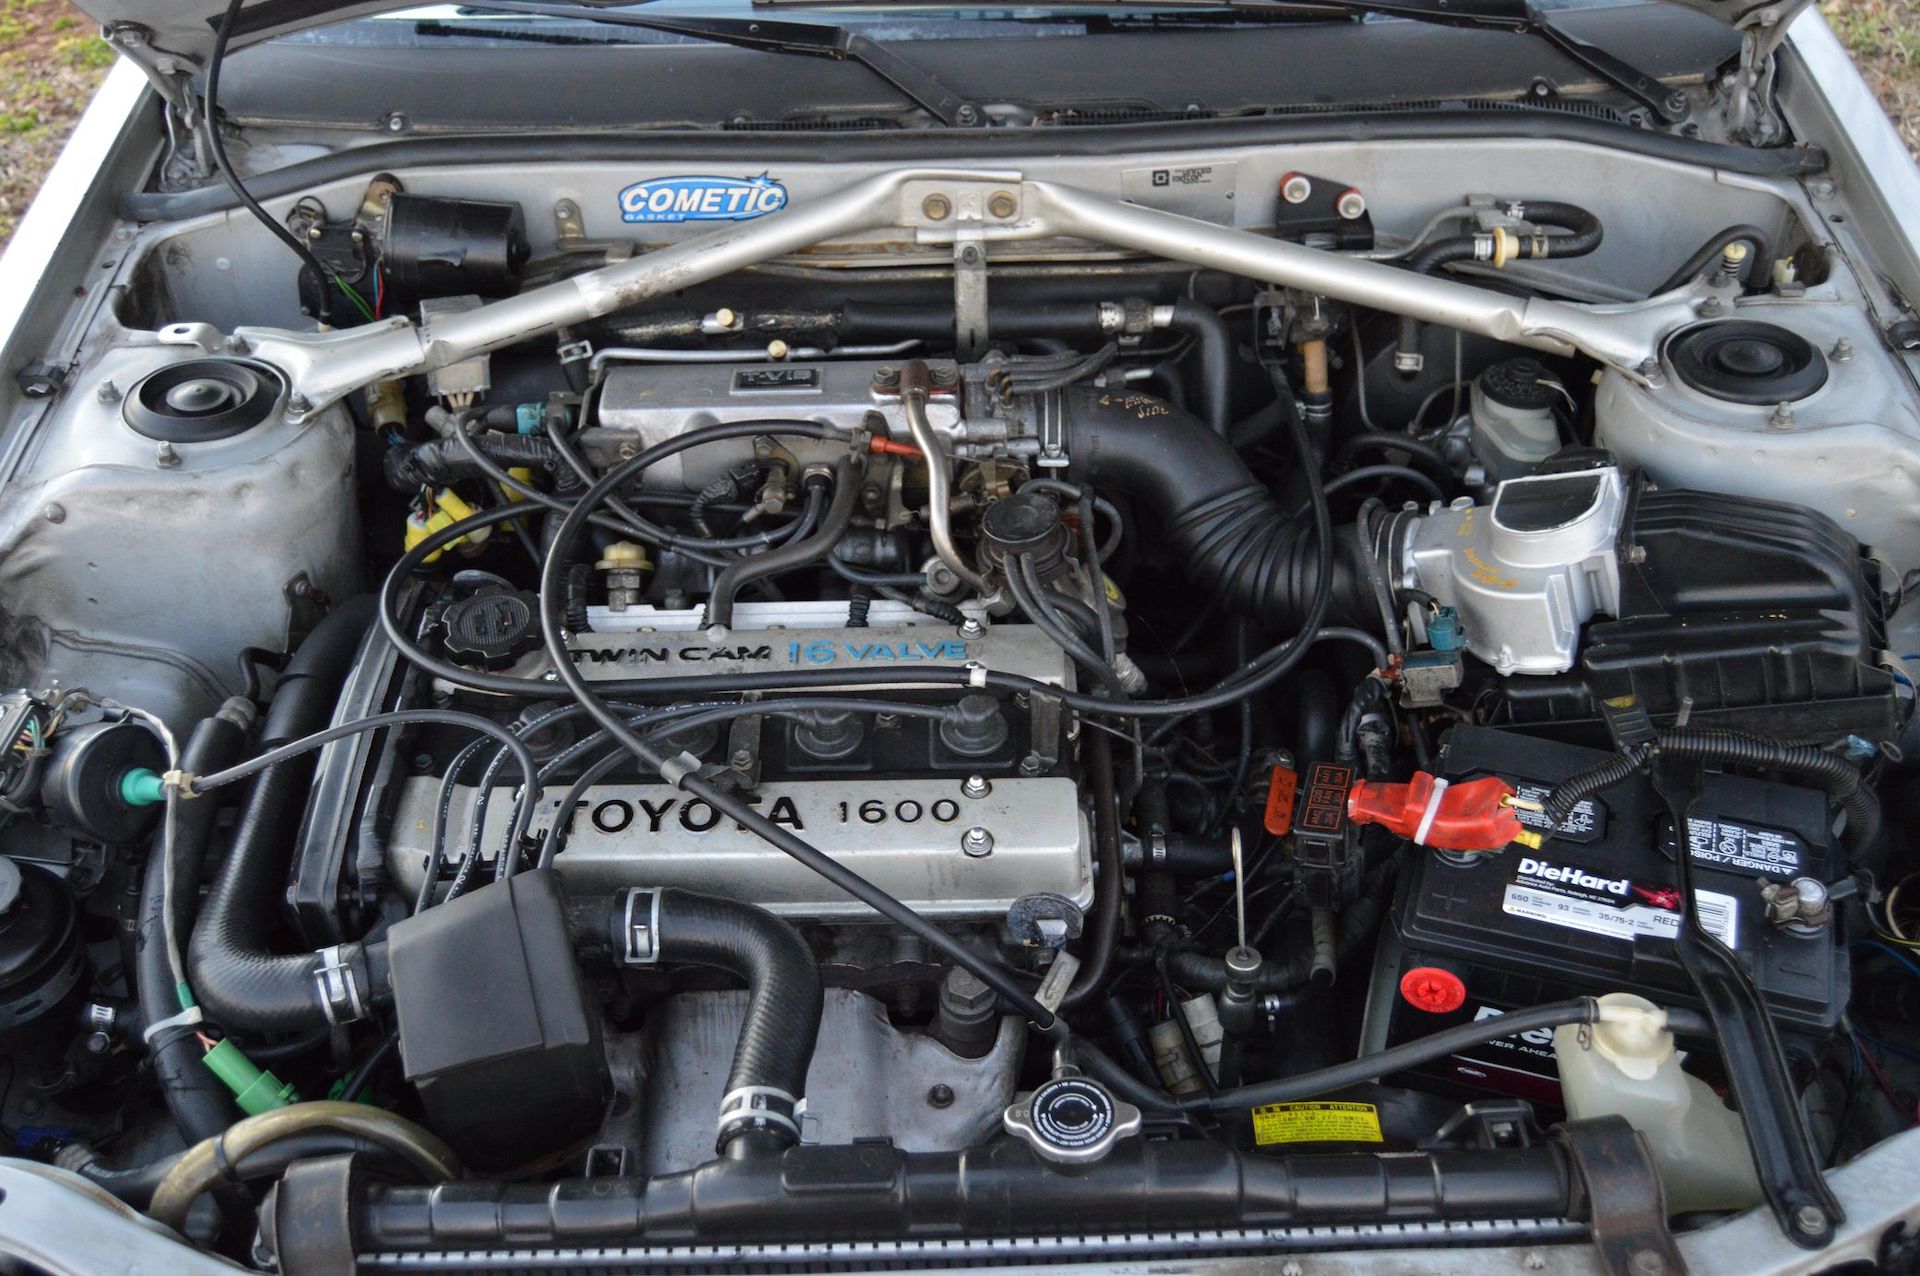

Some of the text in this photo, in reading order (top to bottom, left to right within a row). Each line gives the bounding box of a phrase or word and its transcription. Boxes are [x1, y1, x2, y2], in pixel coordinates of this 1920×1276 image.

[622, 187, 784, 213] COMETIC
[624, 213, 686, 221] GASKET
[679, 646, 770, 661] CAM
[788, 640, 837, 665] 16
[845, 639, 968, 661] VALVE
[838, 799, 960, 824] 1600
[1690, 850, 1720, 861] POIS
[1732, 857, 1781, 874] DANGER
[1517, 858, 1630, 895] DieHard
[1511, 893, 1529, 902] 650
[1598, 912, 1635, 926] 35/75-2
[1518, 1046, 1557, 1060] AHEA
[1329, 1104, 1368, 1112] ATTENTION
